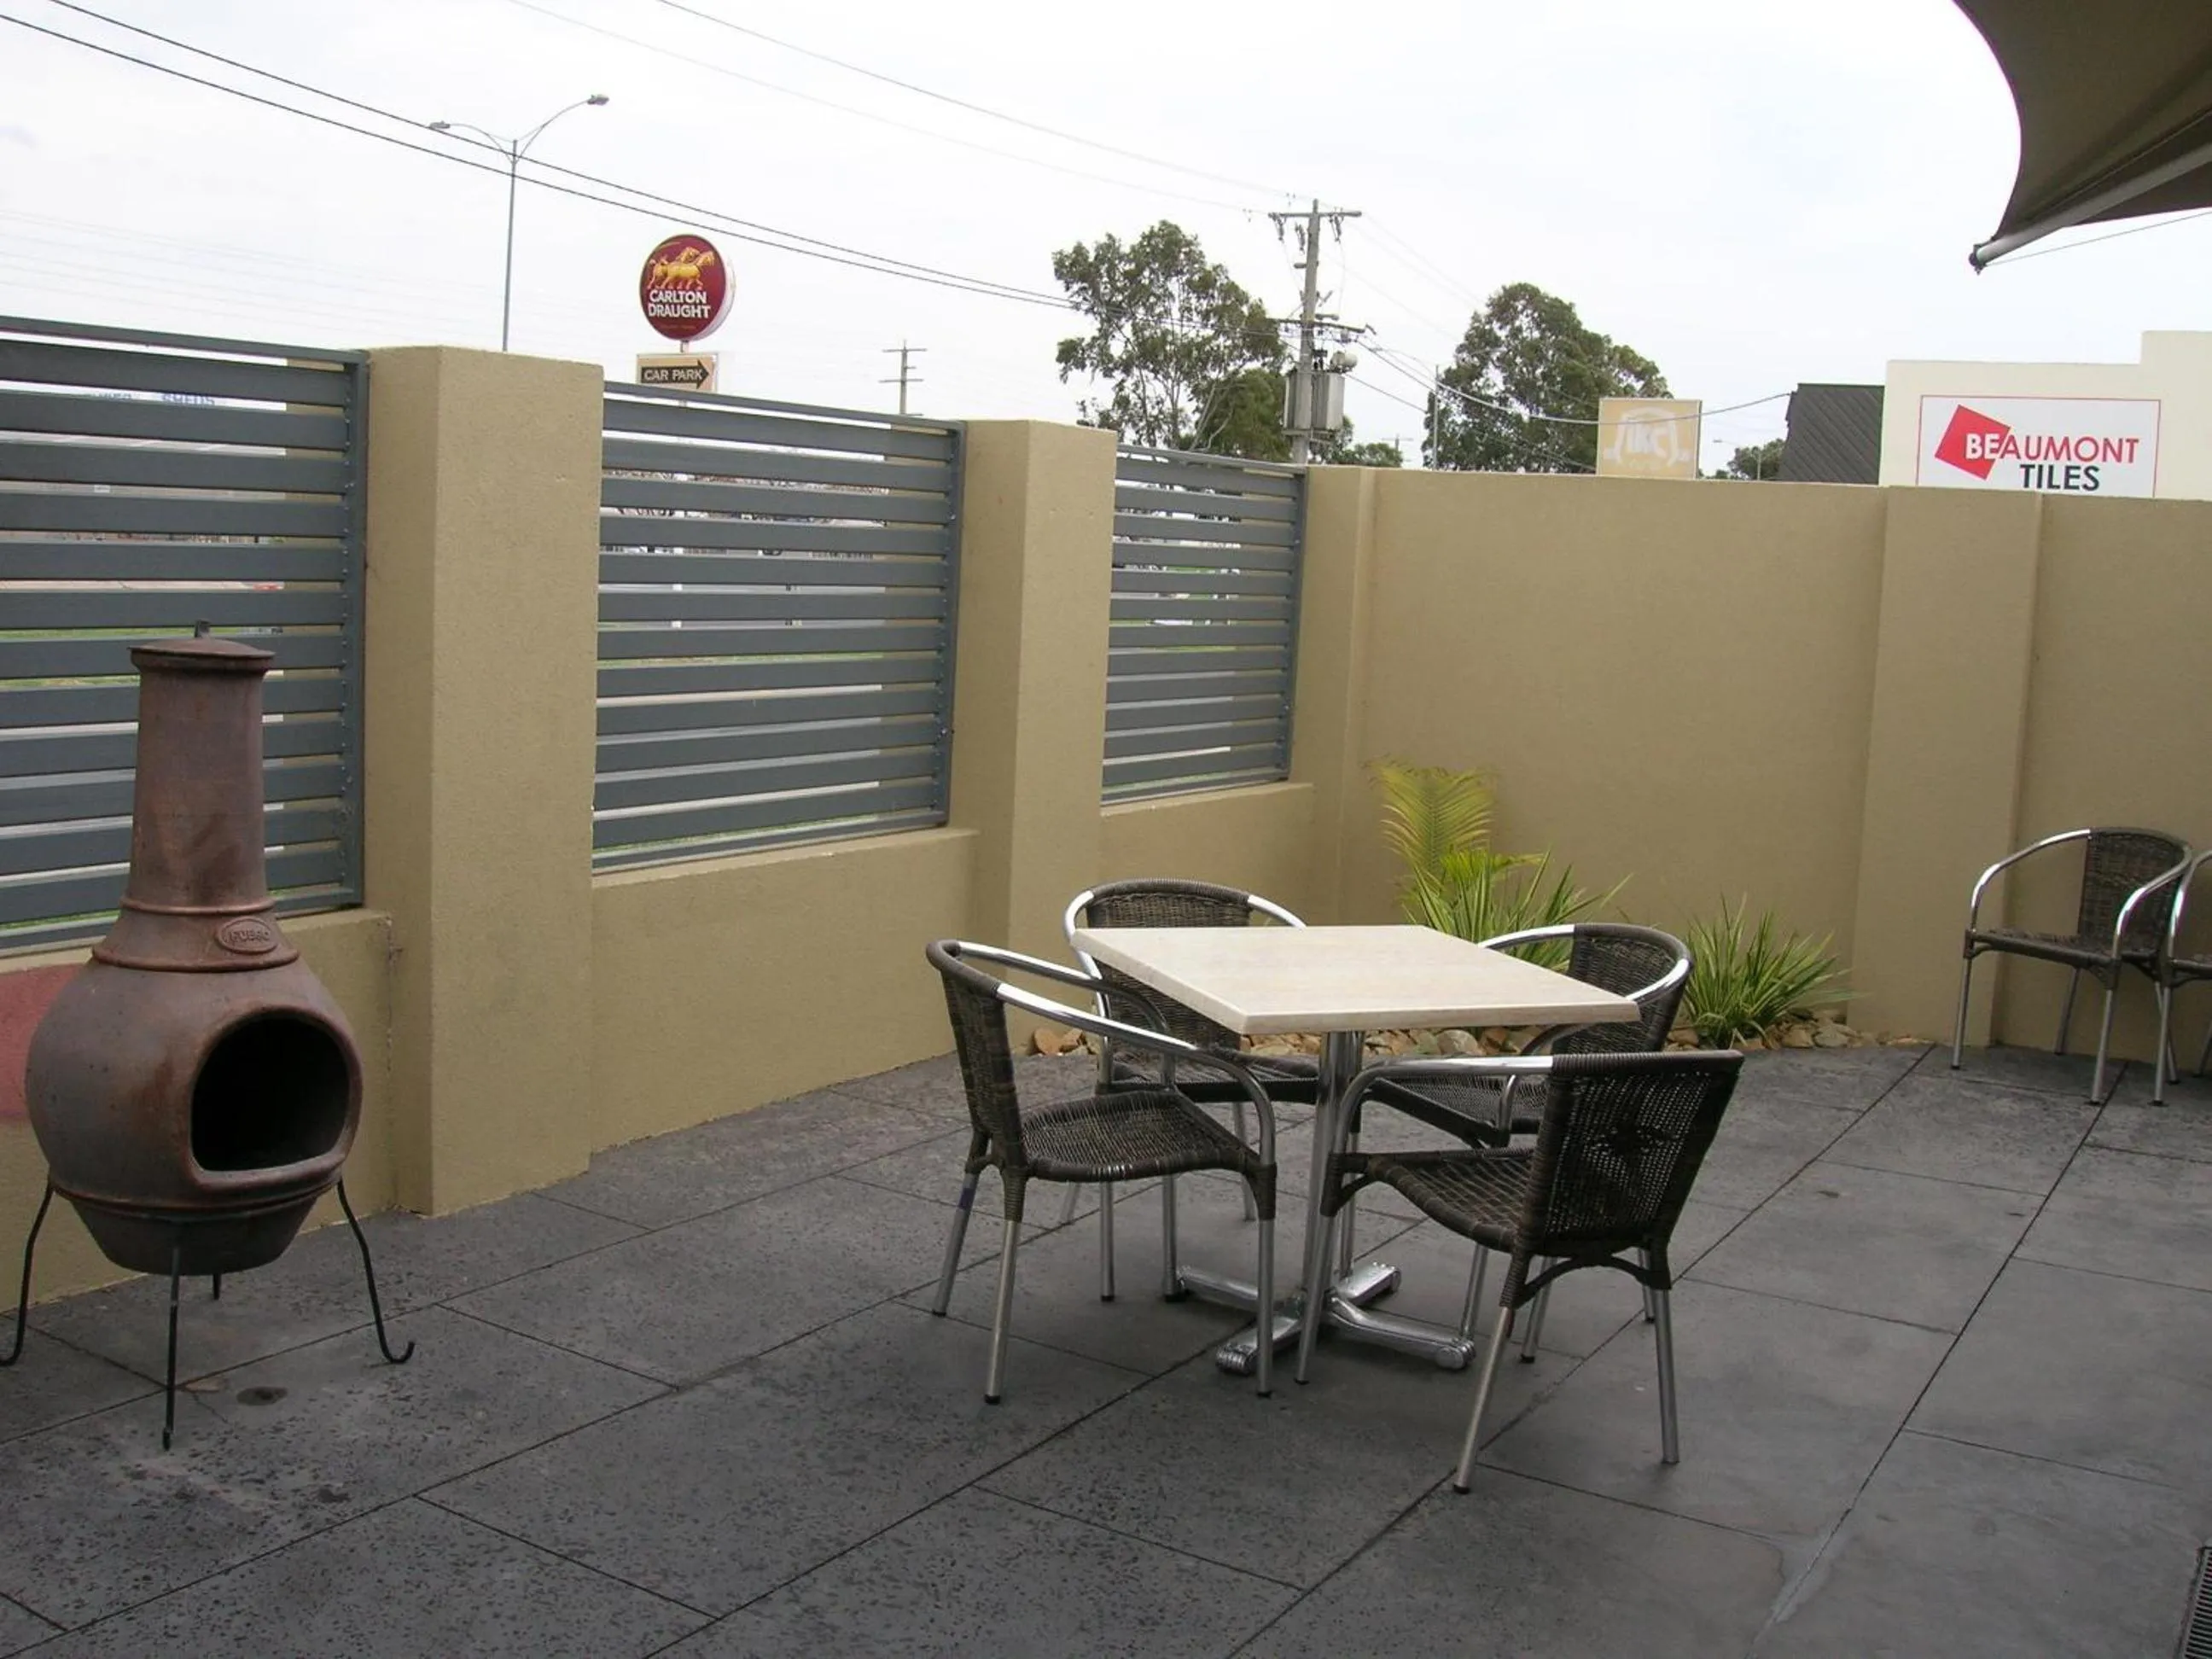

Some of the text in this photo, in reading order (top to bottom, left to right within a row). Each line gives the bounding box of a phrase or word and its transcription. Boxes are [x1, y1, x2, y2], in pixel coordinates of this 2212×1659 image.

[649, 289, 707, 304] CARLTON
[648, 303, 711, 318] DRAUGHT
[643, 369, 703, 381] CAR PARK
[1965, 433, 2139, 463] BEAUMONT
[2019, 463, 2100, 492] TILES
